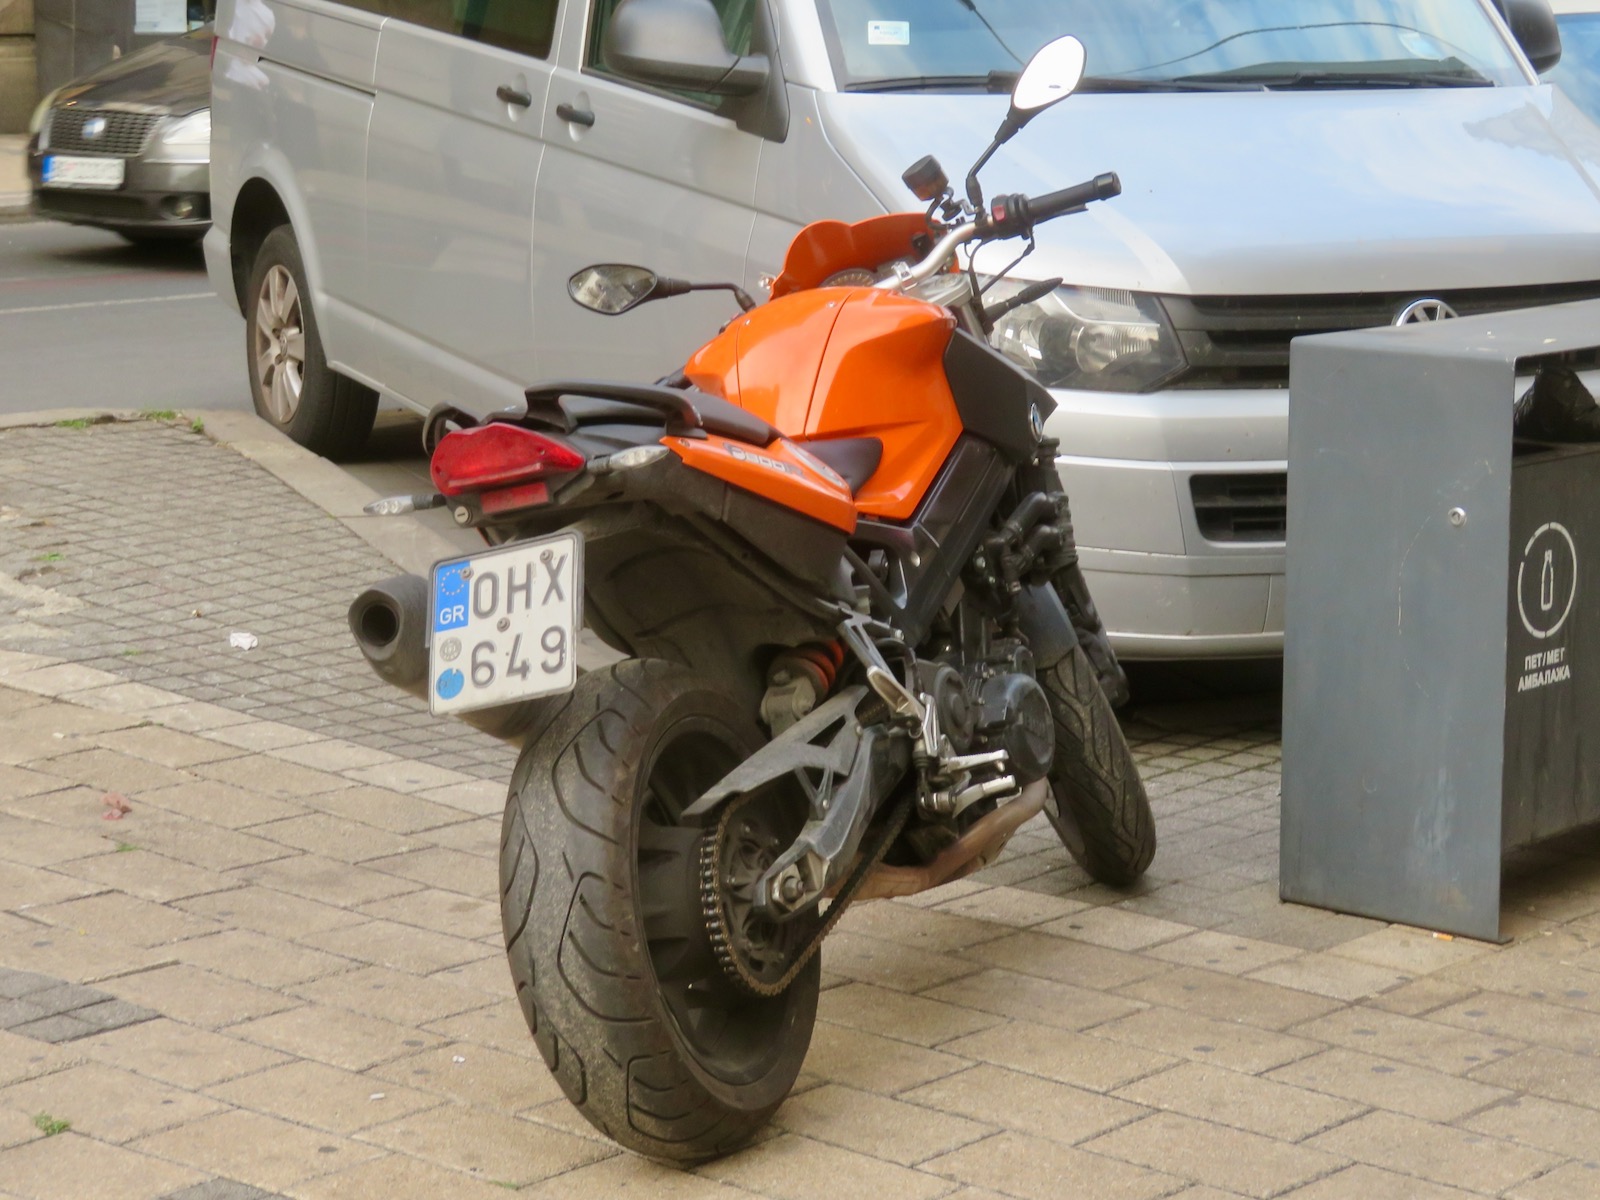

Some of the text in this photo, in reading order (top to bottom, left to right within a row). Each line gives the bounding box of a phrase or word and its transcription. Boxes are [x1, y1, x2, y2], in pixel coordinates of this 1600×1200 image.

[472, 552, 568, 620] OHX
[439, 604, 465, 625] GR
[471, 625, 568, 689] 649
[1517, 664, 1571, 693] АМБАЛАЖА
